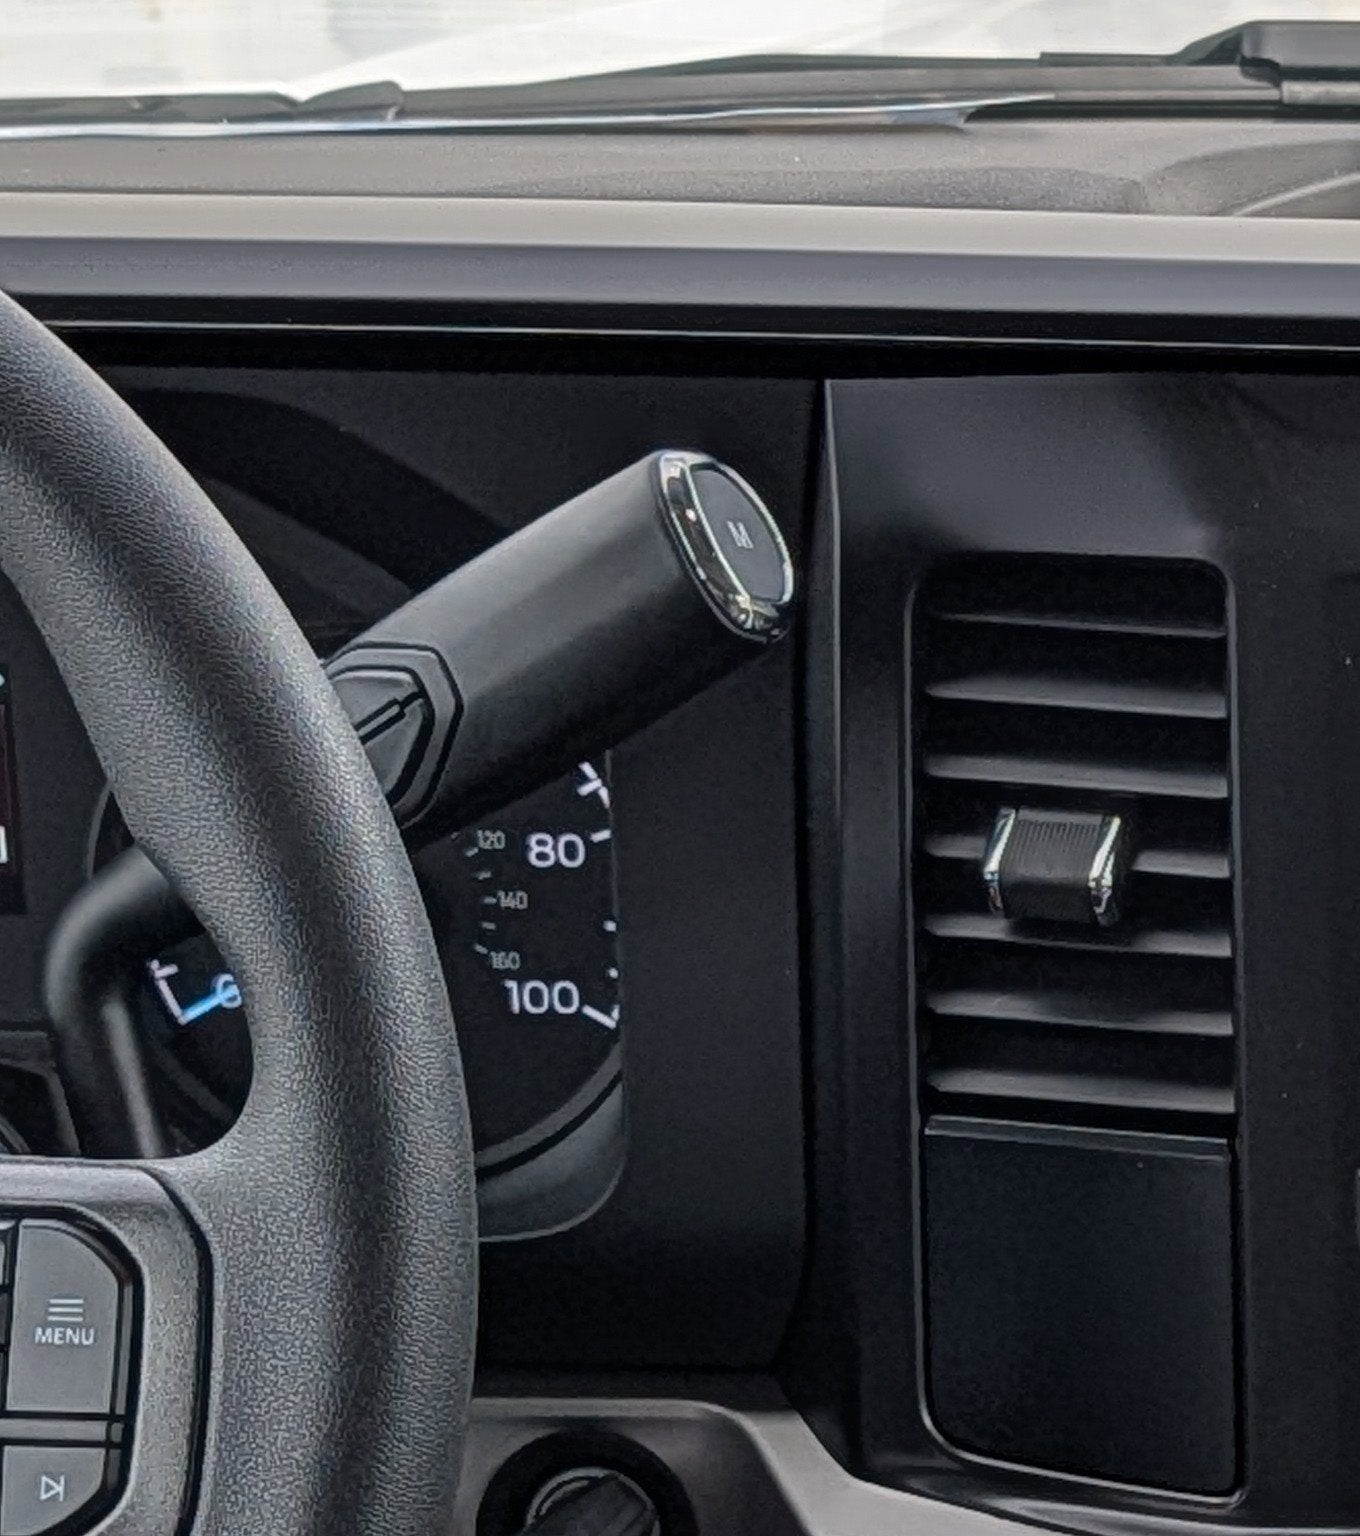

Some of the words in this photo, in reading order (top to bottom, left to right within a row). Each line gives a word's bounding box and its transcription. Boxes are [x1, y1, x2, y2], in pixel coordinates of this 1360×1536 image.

[528, 832, 586, 868] 80
[504, 980, 580, 1014] 100
[34, 1327, 95, 1346] MENU
